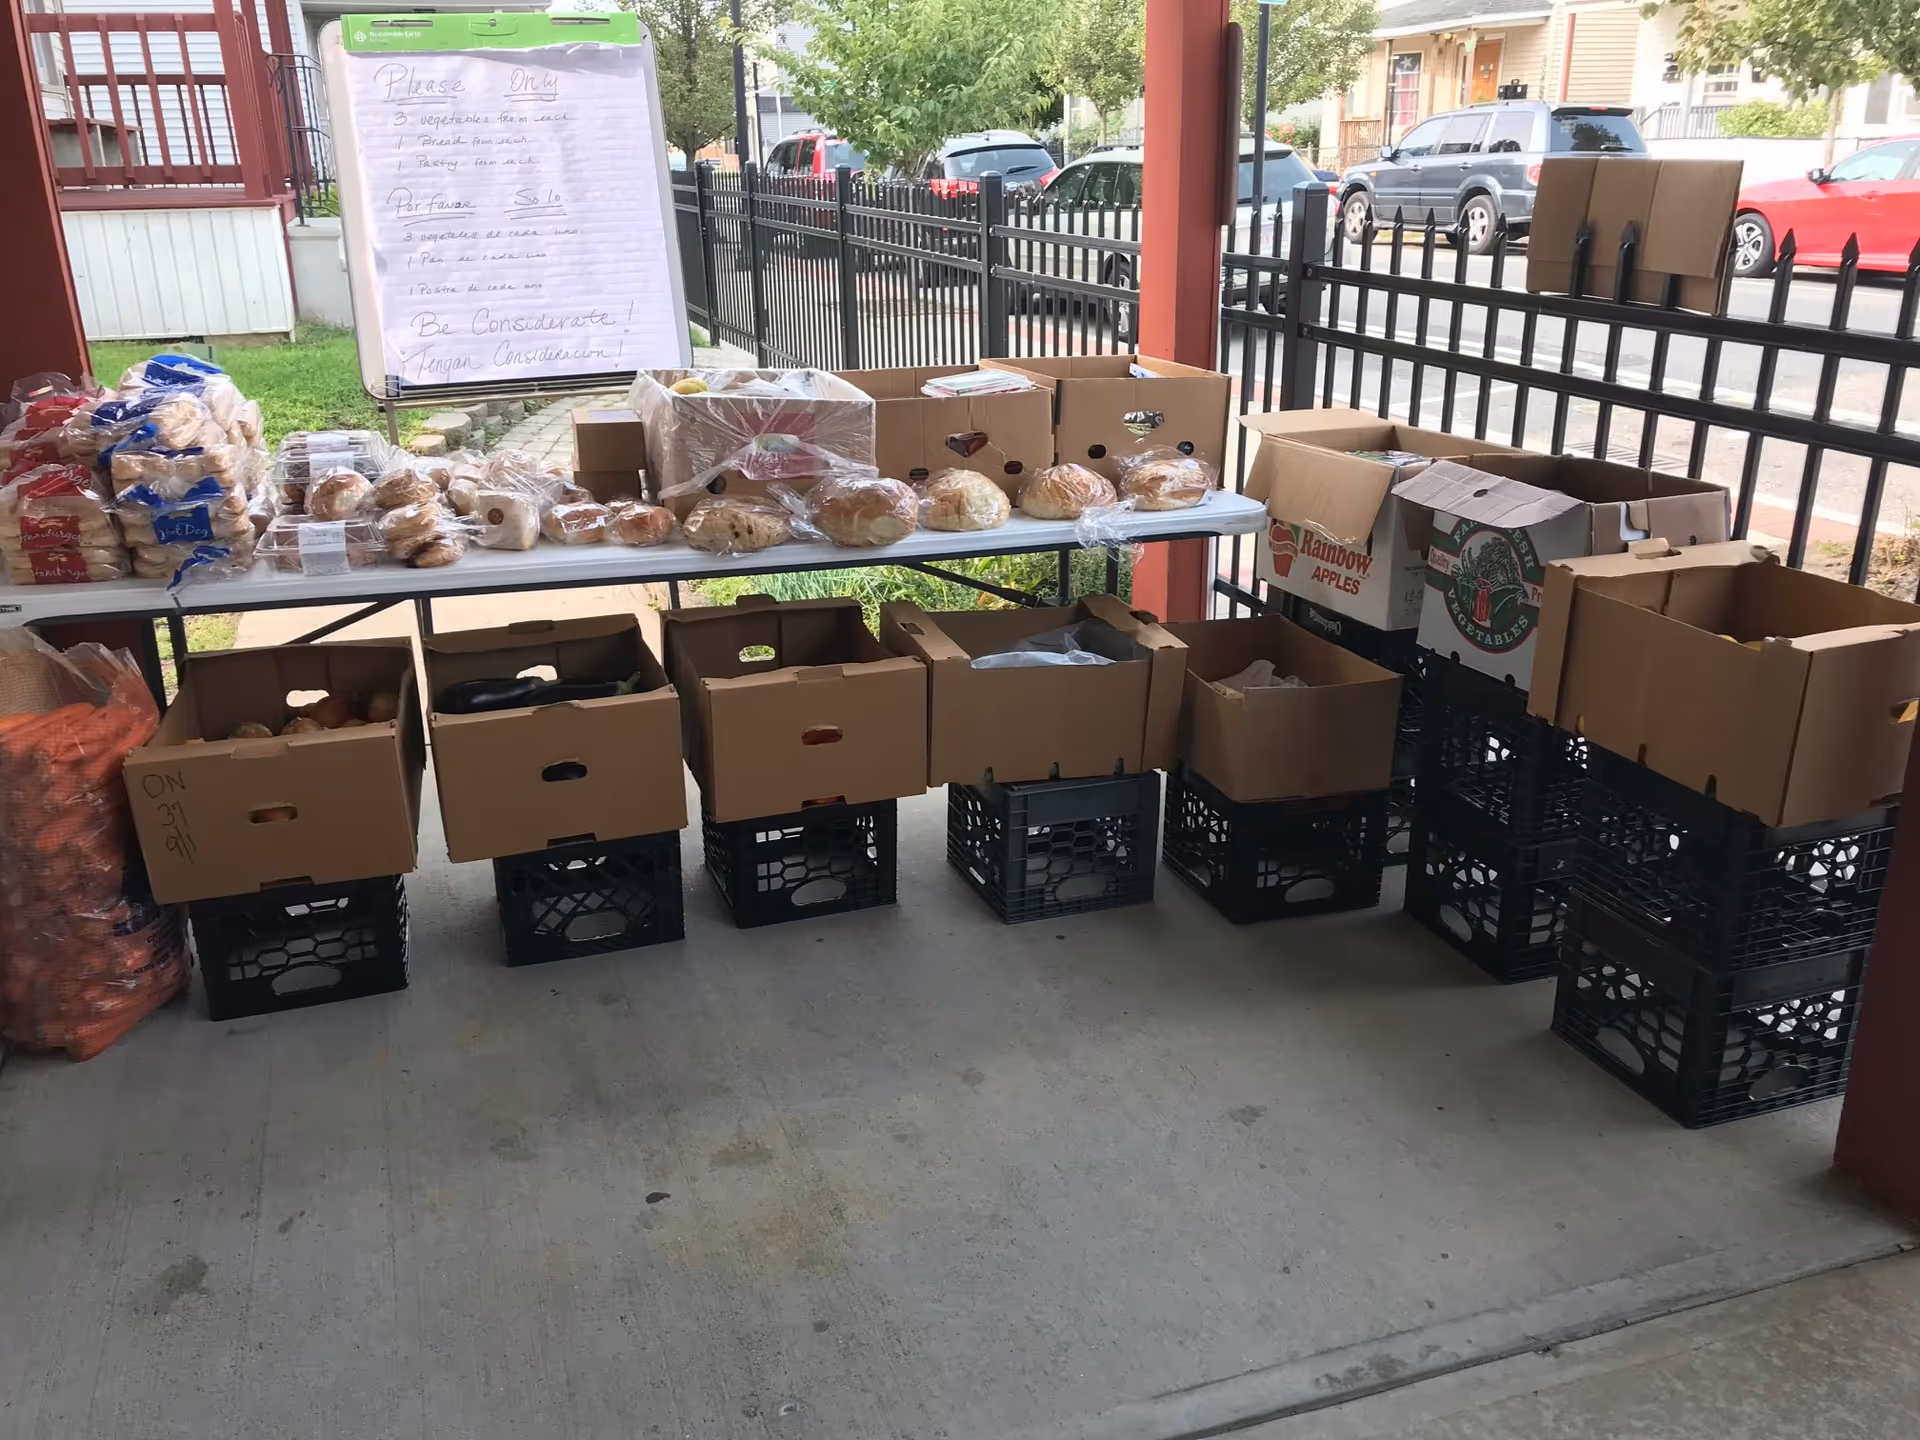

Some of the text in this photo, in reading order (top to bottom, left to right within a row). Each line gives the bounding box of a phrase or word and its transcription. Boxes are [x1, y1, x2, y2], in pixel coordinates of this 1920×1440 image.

[374, 63, 558, 98] Please Only
[393, 111, 408, 126] 3
[420, 111, 490, 130] vegetables
[417, 134, 470, 147] Bread
[416, 155, 458, 171] Pastry
[514, 187, 561, 206] Solo
[486, 229, 502, 239] de
[508, 228, 540, 237] cada
[420, 251, 444, 266] Pan
[457, 253, 474, 262] de
[411, 311, 457, 337] Be
[1300, 529, 1374, 575] Rainbow
[1311, 566, 1361, 595] APPLES
[1448, 587, 1528, 646] VEGETABLES
[142, 770, 186, 799] ON
